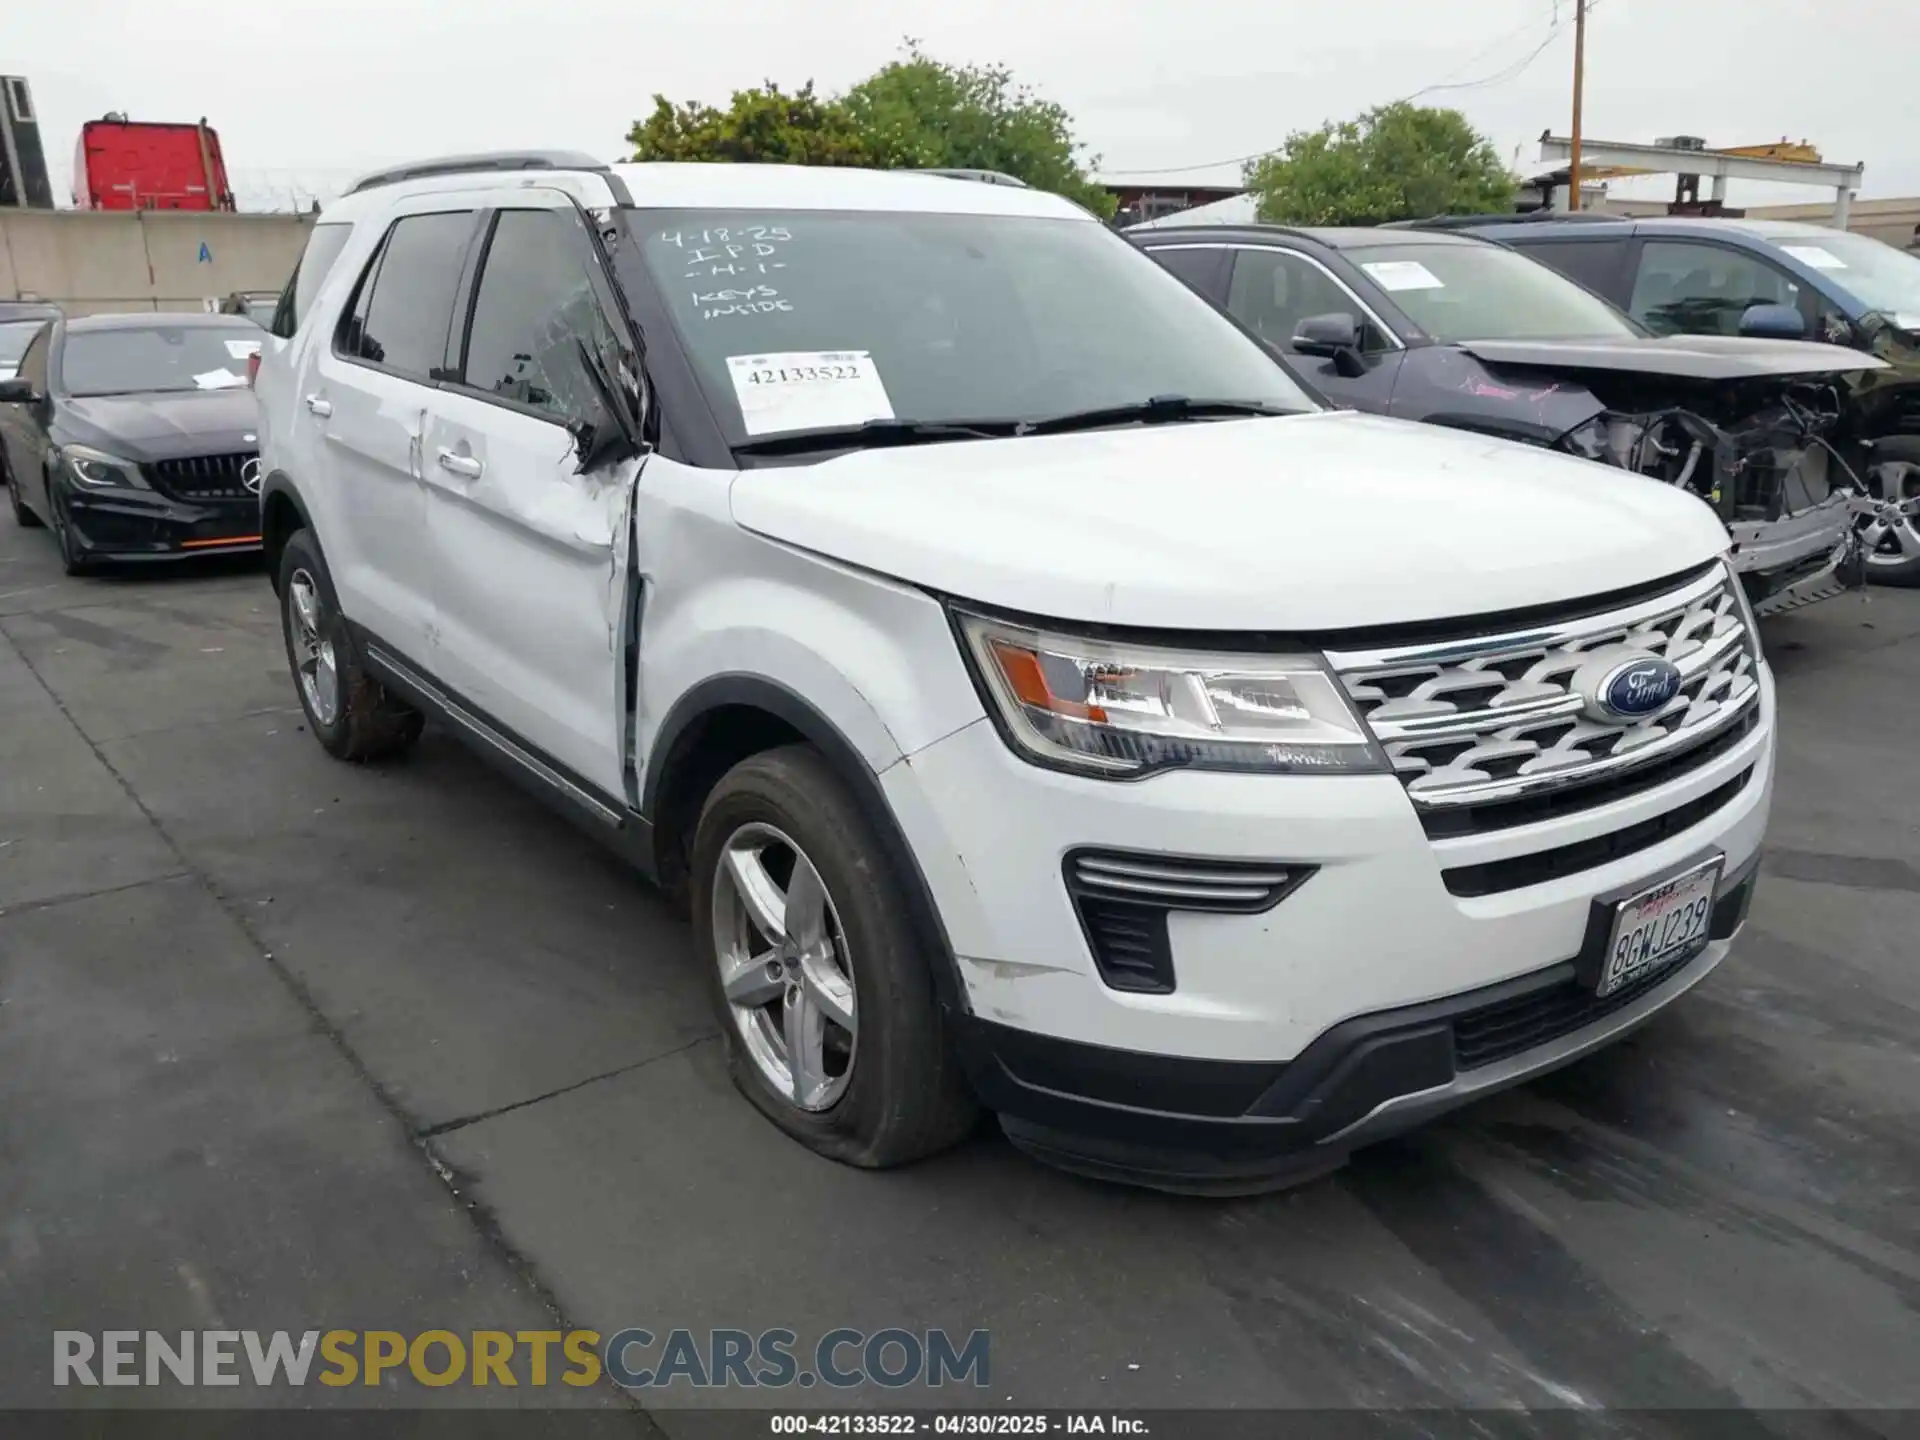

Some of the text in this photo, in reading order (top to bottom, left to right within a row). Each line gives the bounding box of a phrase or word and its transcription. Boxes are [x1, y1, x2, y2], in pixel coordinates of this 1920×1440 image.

[199, 241, 212, 263] A
[749, 366, 861, 385] 42133522
[1626, 667, 1672, 705] Ford
[1612, 895, 1708, 976] 8GWJ239
